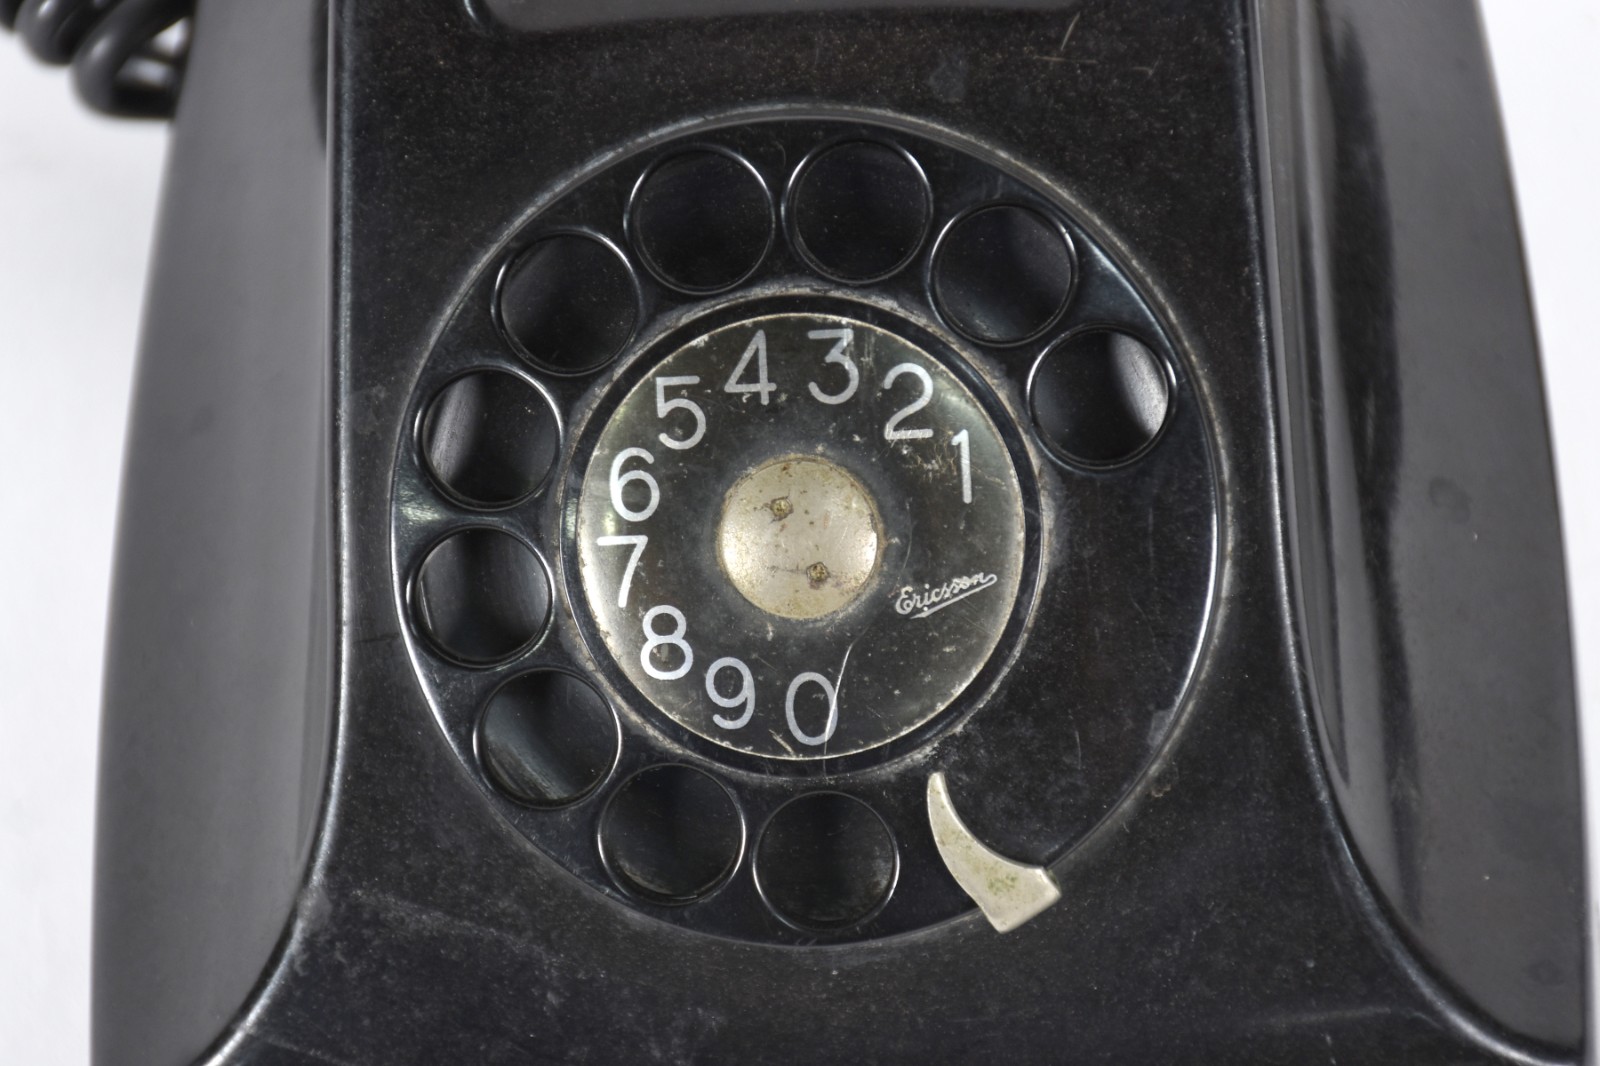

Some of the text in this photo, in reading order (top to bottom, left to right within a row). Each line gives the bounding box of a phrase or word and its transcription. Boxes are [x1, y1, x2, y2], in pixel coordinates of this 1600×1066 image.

[724, 329, 777, 405] 4
[808, 328, 859, 404] 3
[884, 363, 933, 440] 2
[655, 376, 706, 450] 5
[608, 447, 660, 522] 6
[951, 429, 972, 504] 1
[597, 534, 648, 608] 7
[895, 572, 998, 618] Ericsson
[639, 604, 694, 681] 8
[705, 656, 756, 730] 9
[785, 671, 838, 746] 0
